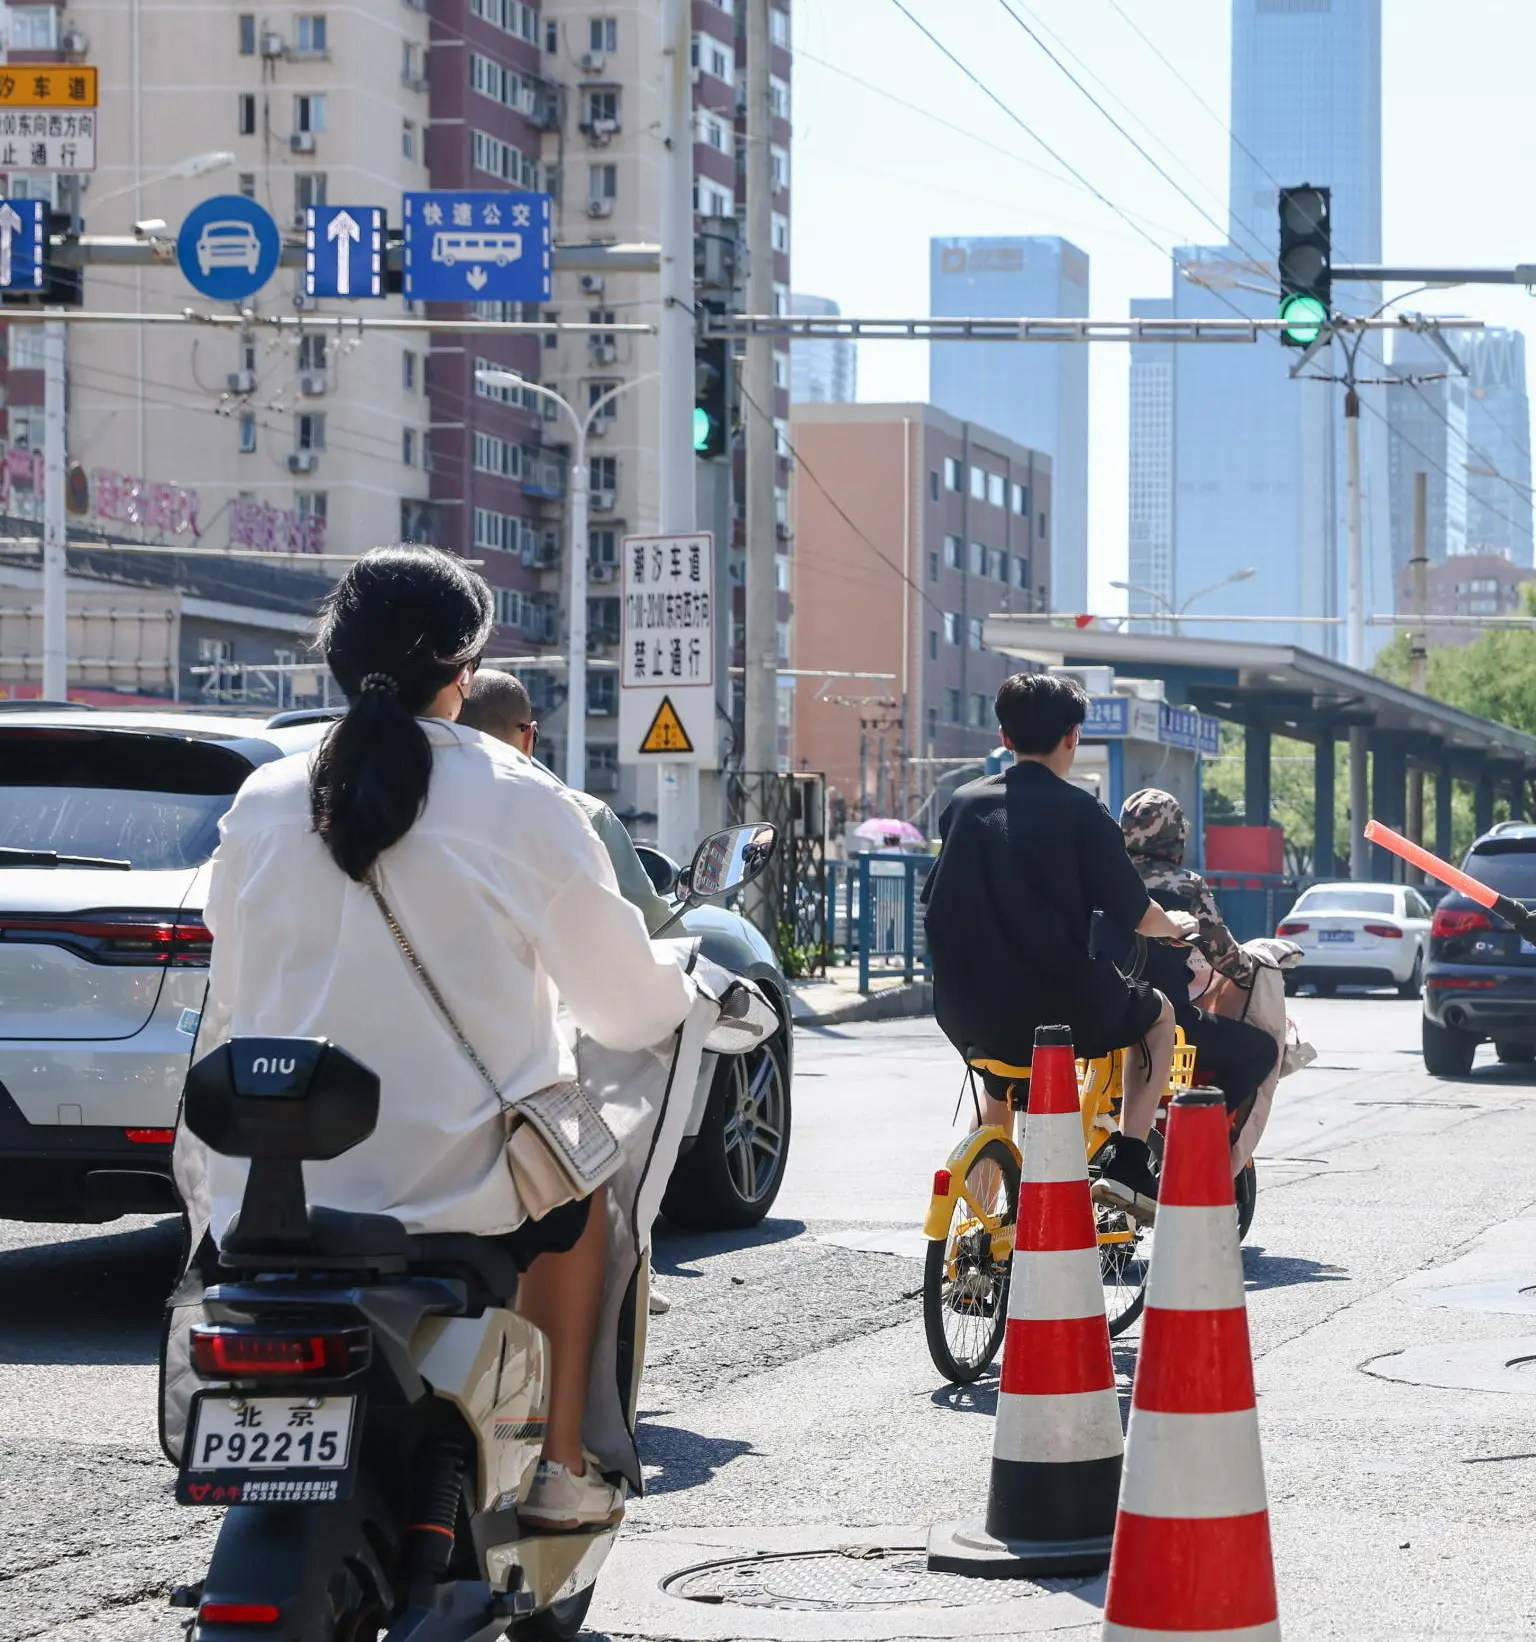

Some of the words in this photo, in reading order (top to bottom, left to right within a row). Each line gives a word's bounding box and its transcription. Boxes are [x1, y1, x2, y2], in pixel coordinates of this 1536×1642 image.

[2, 142, 78, 167] 止通行
[422, 201, 531, 227] 快速公交
[633, 543, 701, 584] 潮汐车道
[634, 637, 701, 678] 禁止通行
[234, 1405, 314, 1428] 北京
[202, 1430, 338, 1463] P92215
